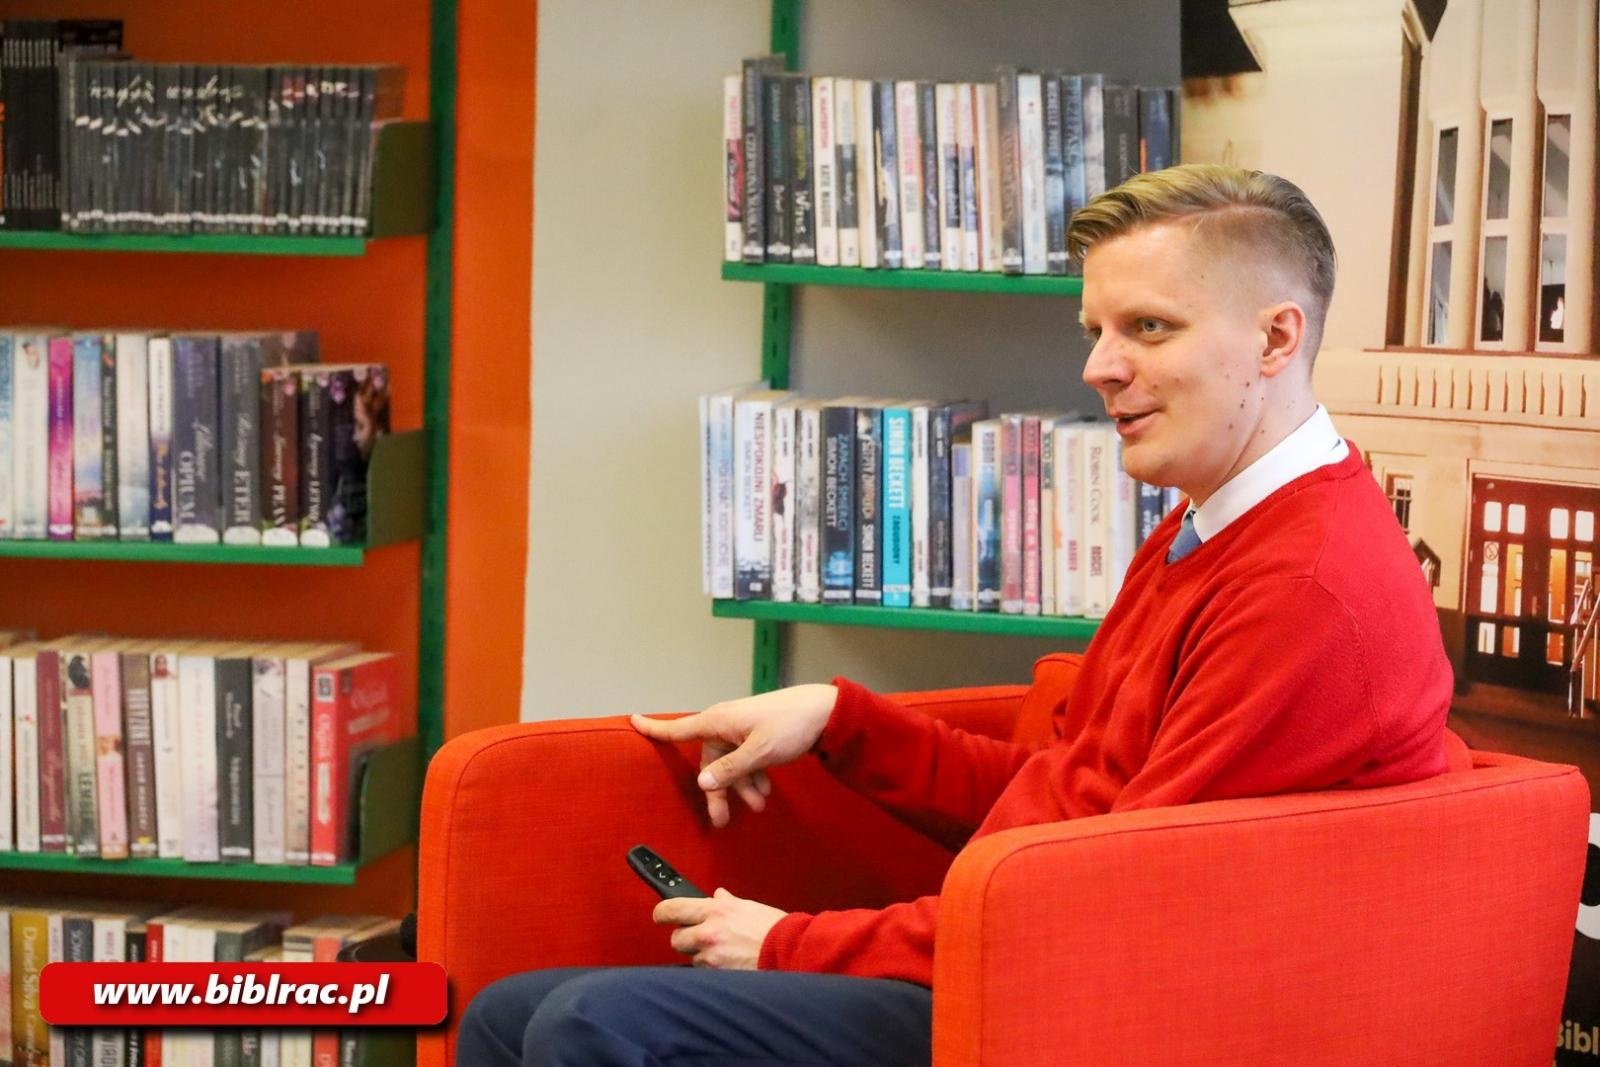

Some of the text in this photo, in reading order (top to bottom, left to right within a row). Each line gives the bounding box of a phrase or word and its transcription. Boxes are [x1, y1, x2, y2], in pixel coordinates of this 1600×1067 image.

[753, 412, 765, 493] NIESPOKOJNI
[826, 436, 837, 528] SIMON BECKETT
[888, 416, 906, 509] SIMON BECKETT
[862, 553, 874, 588] BECKETT
[22, 925, 37, 971] Daniel
[22, 973, 37, 1009] Silva
